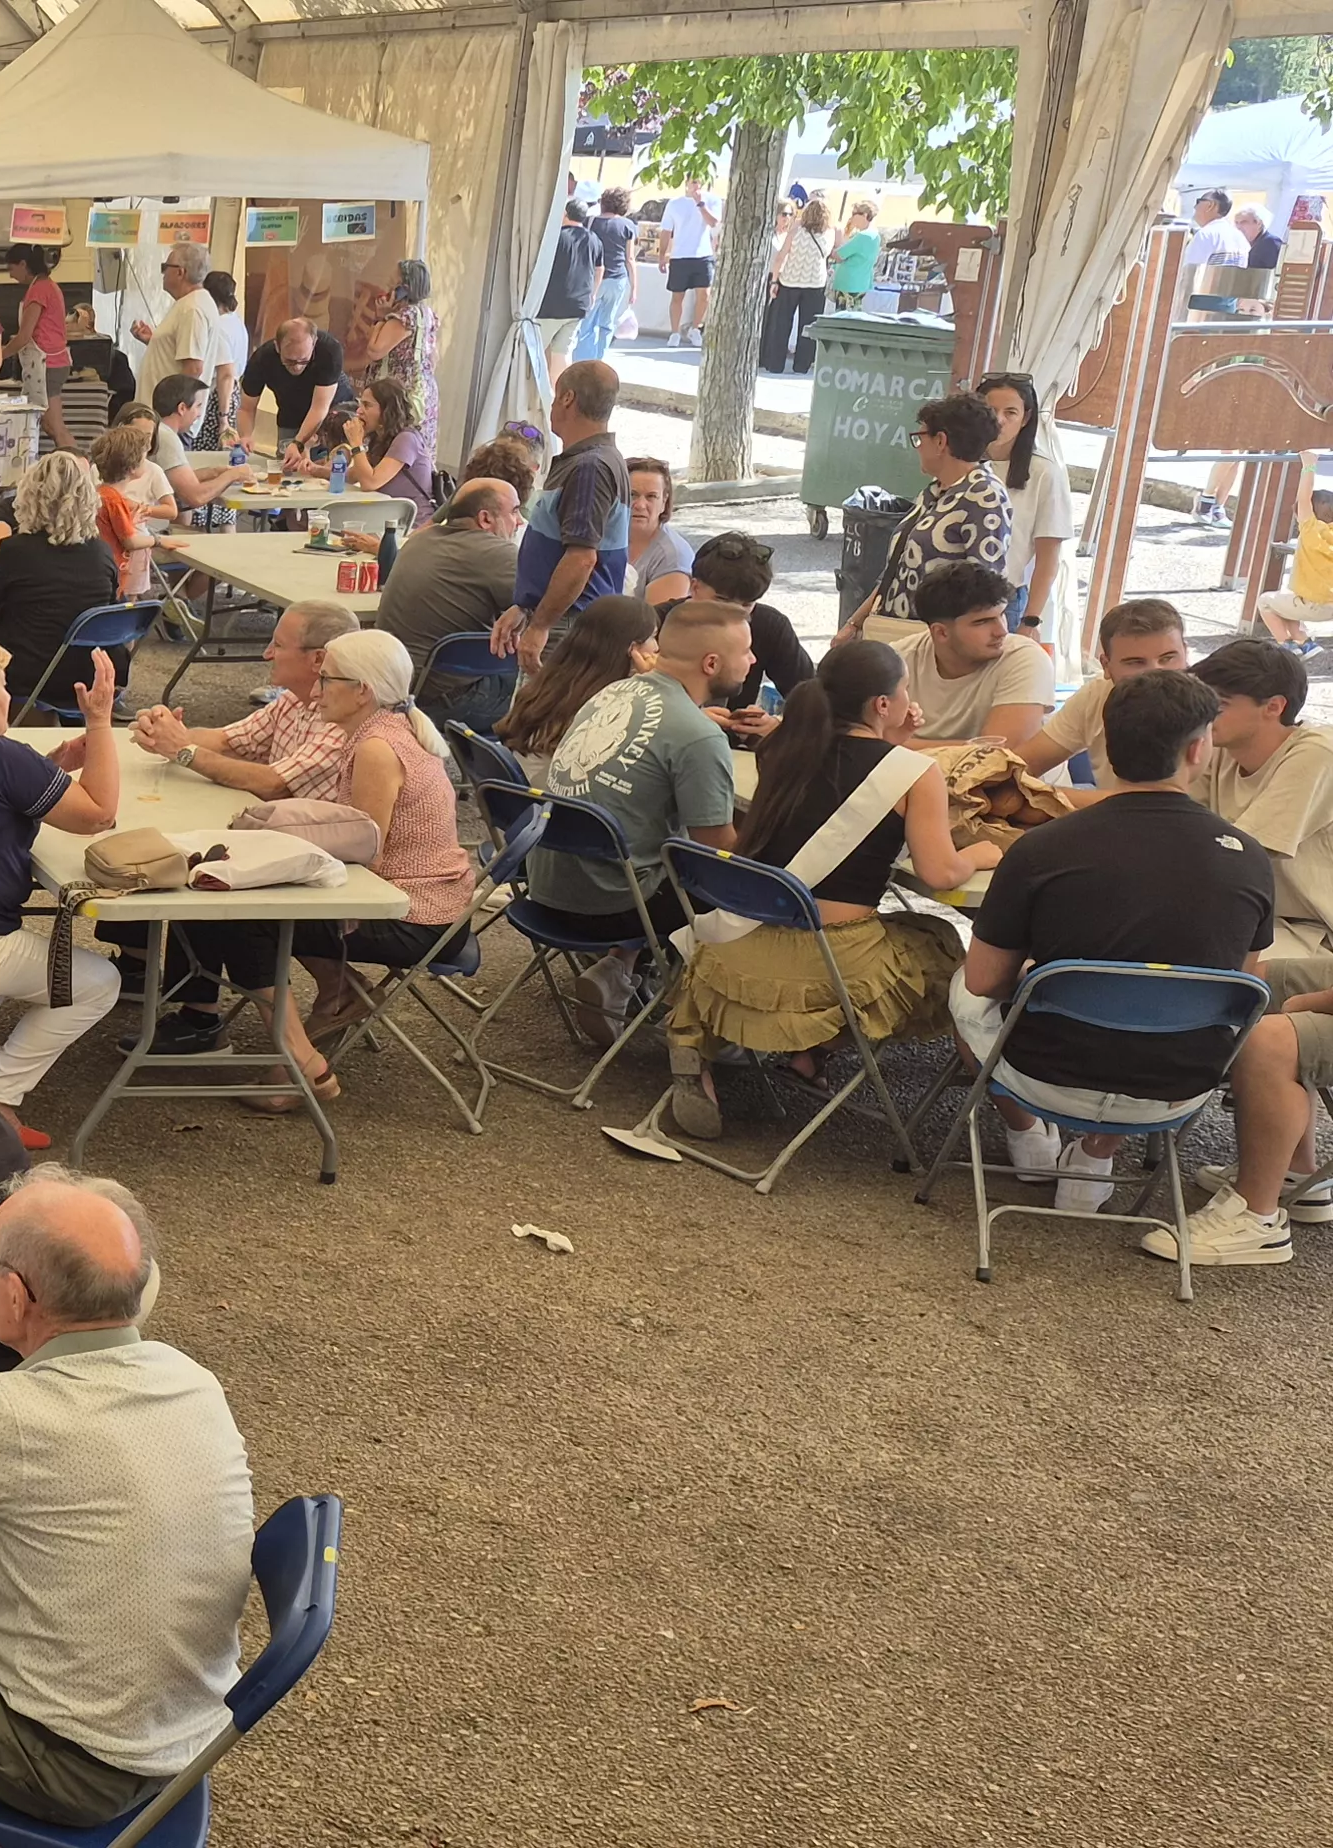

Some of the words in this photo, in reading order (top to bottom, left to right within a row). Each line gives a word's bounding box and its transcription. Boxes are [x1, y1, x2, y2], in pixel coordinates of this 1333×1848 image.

[817, 366, 945, 400] COMARCA
[834, 416, 907, 448] HOYA
[617, 692, 664, 772] MONKEY
